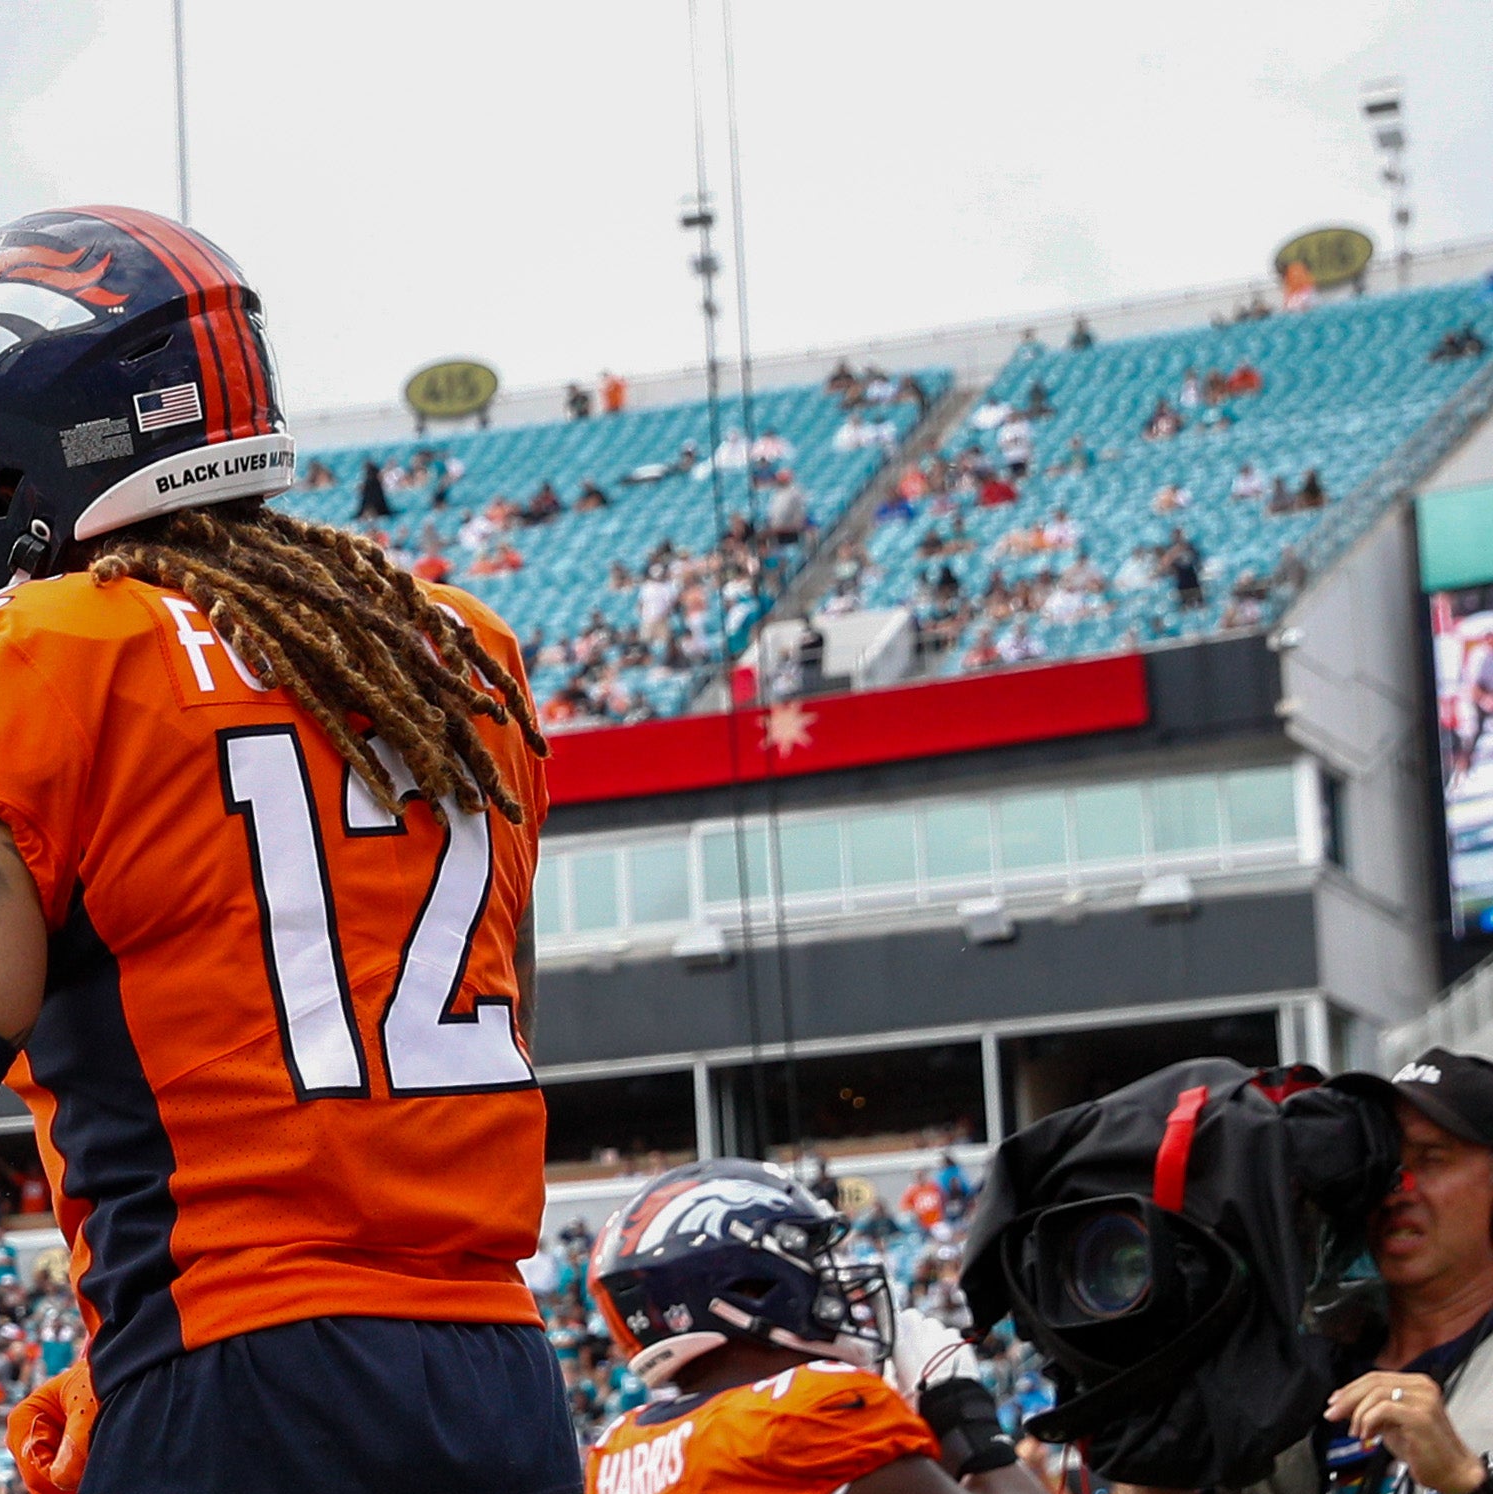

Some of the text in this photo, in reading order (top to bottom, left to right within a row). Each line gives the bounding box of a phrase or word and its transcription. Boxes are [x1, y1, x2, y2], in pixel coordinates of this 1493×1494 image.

[155, 461, 220, 493] BLACK
[223, 453, 268, 476] LIVES
[217, 723, 539, 1101] 12
